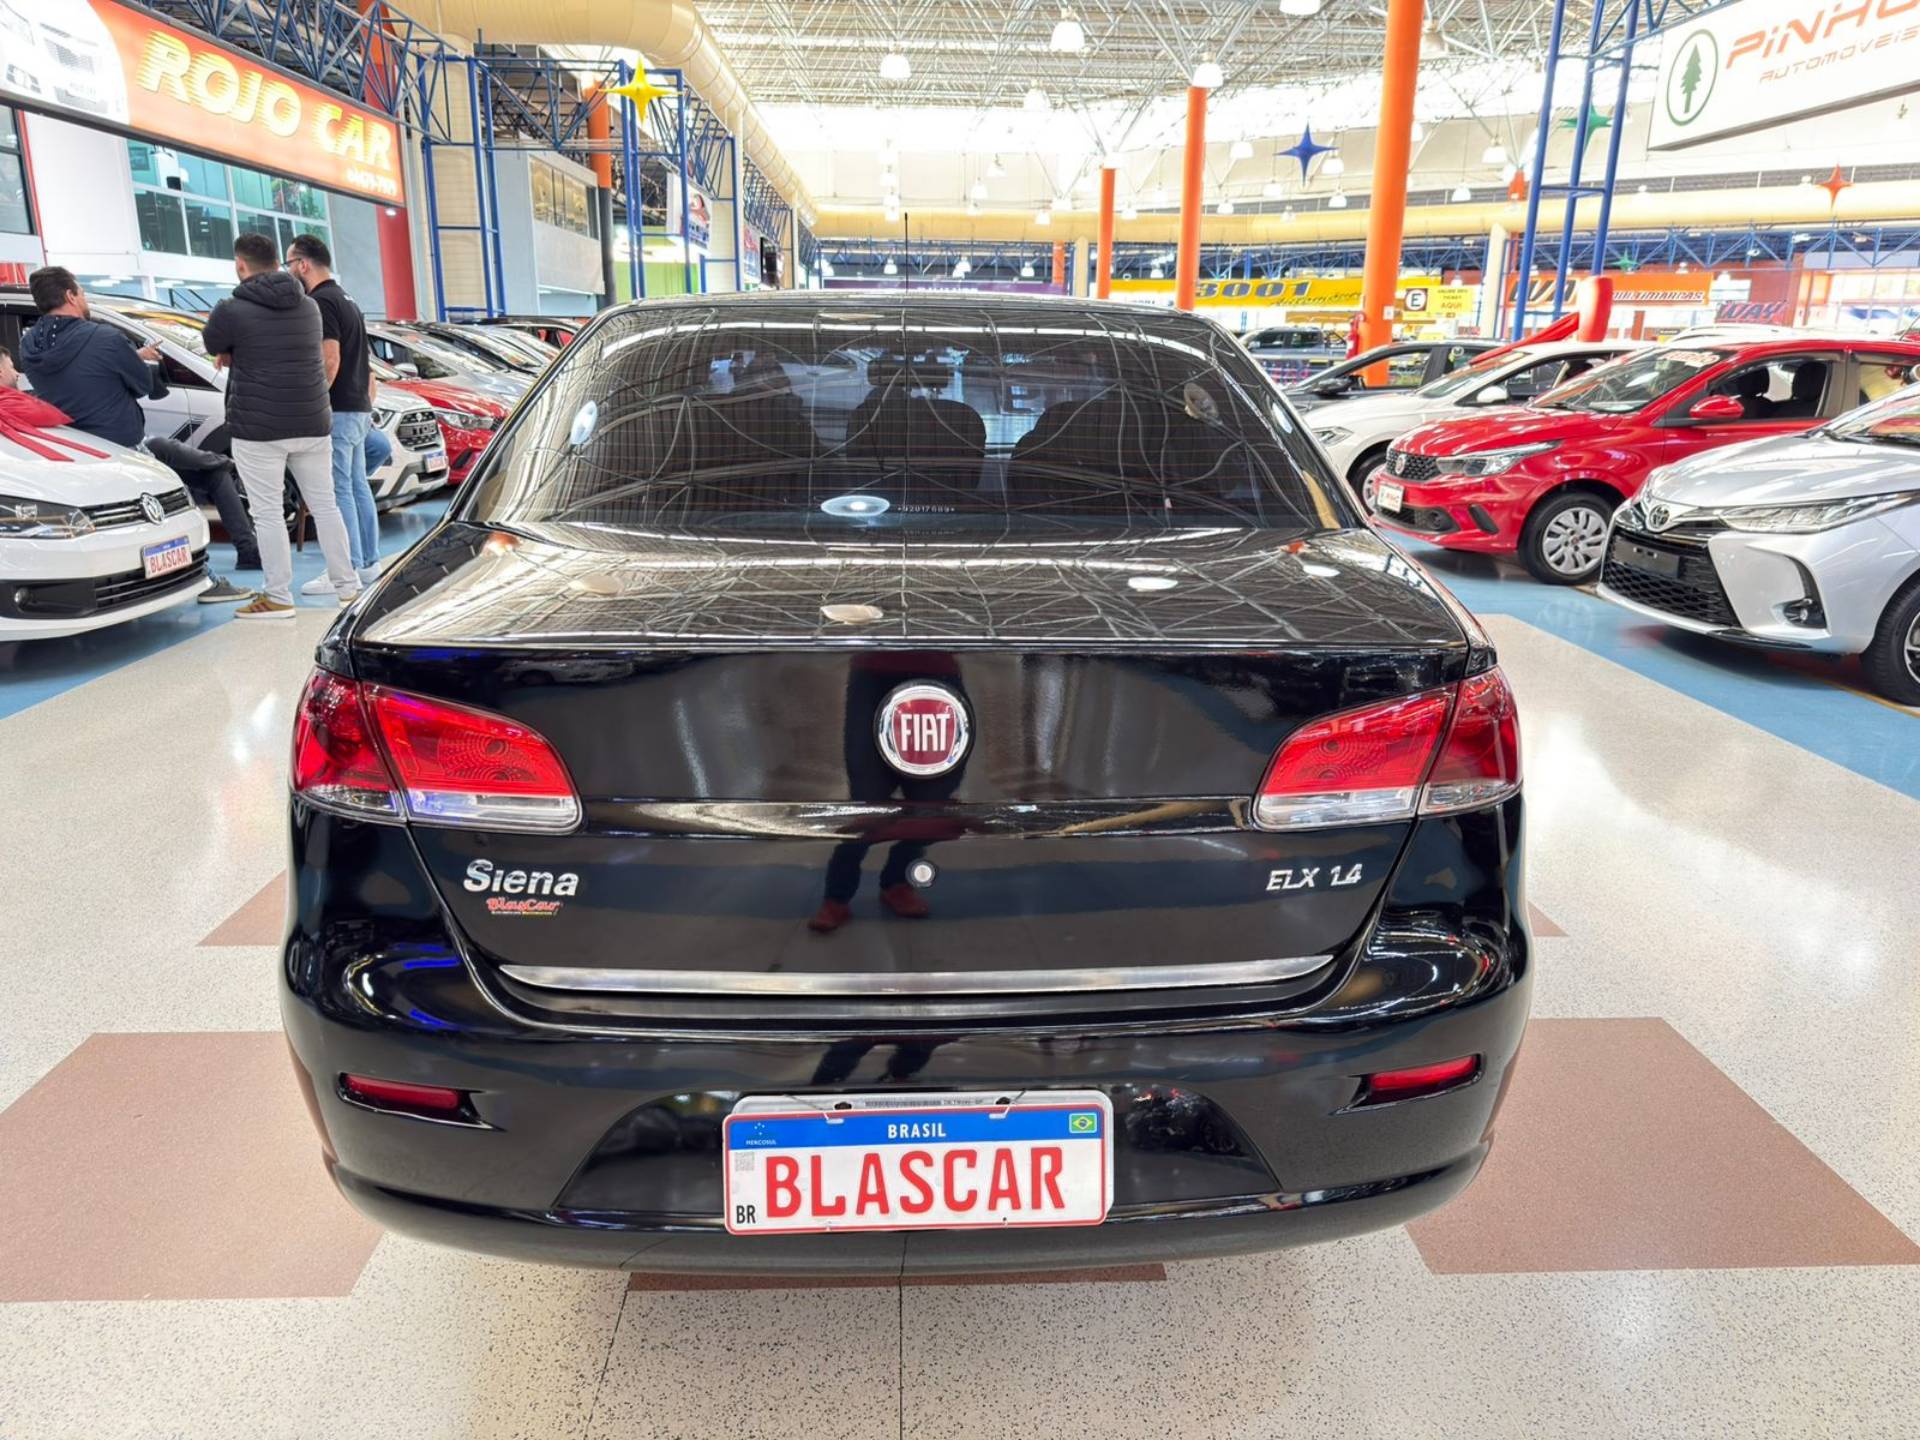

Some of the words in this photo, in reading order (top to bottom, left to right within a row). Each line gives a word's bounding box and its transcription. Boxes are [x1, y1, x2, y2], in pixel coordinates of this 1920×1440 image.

[136, 29, 301, 137] ROJO
[311, 102, 392, 171] CAR
[1411, 293, 1421, 307] E
[150, 546, 188, 573] BLASCAR
[900, 713, 951, 752] FIAT
[463, 859, 579, 896] Siena
[1265, 867, 1320, 891] ELX
[887, 1122, 947, 1139] BRASIL
[766, 1146, 1065, 1219] BLASCAR
[736, 1204, 757, 1224] BR
